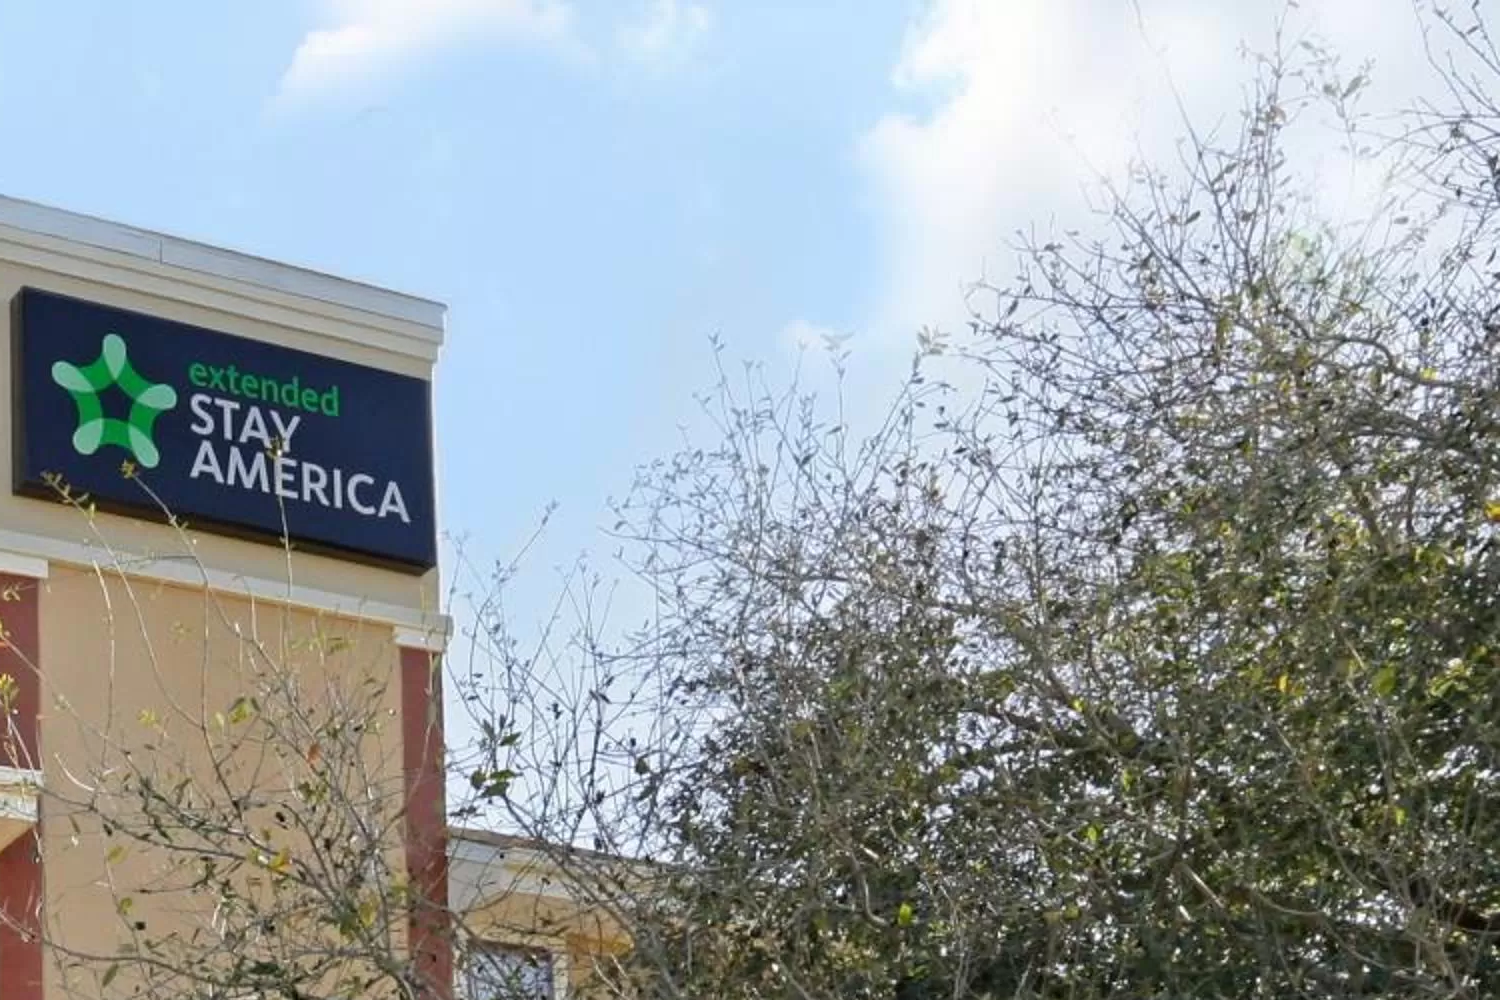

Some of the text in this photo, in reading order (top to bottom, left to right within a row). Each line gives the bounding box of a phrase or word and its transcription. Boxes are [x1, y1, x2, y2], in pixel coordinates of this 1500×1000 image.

[189, 361, 340, 417] extended
[190, 394, 300, 452] STAY
[190, 441, 410, 523] AMERICA
